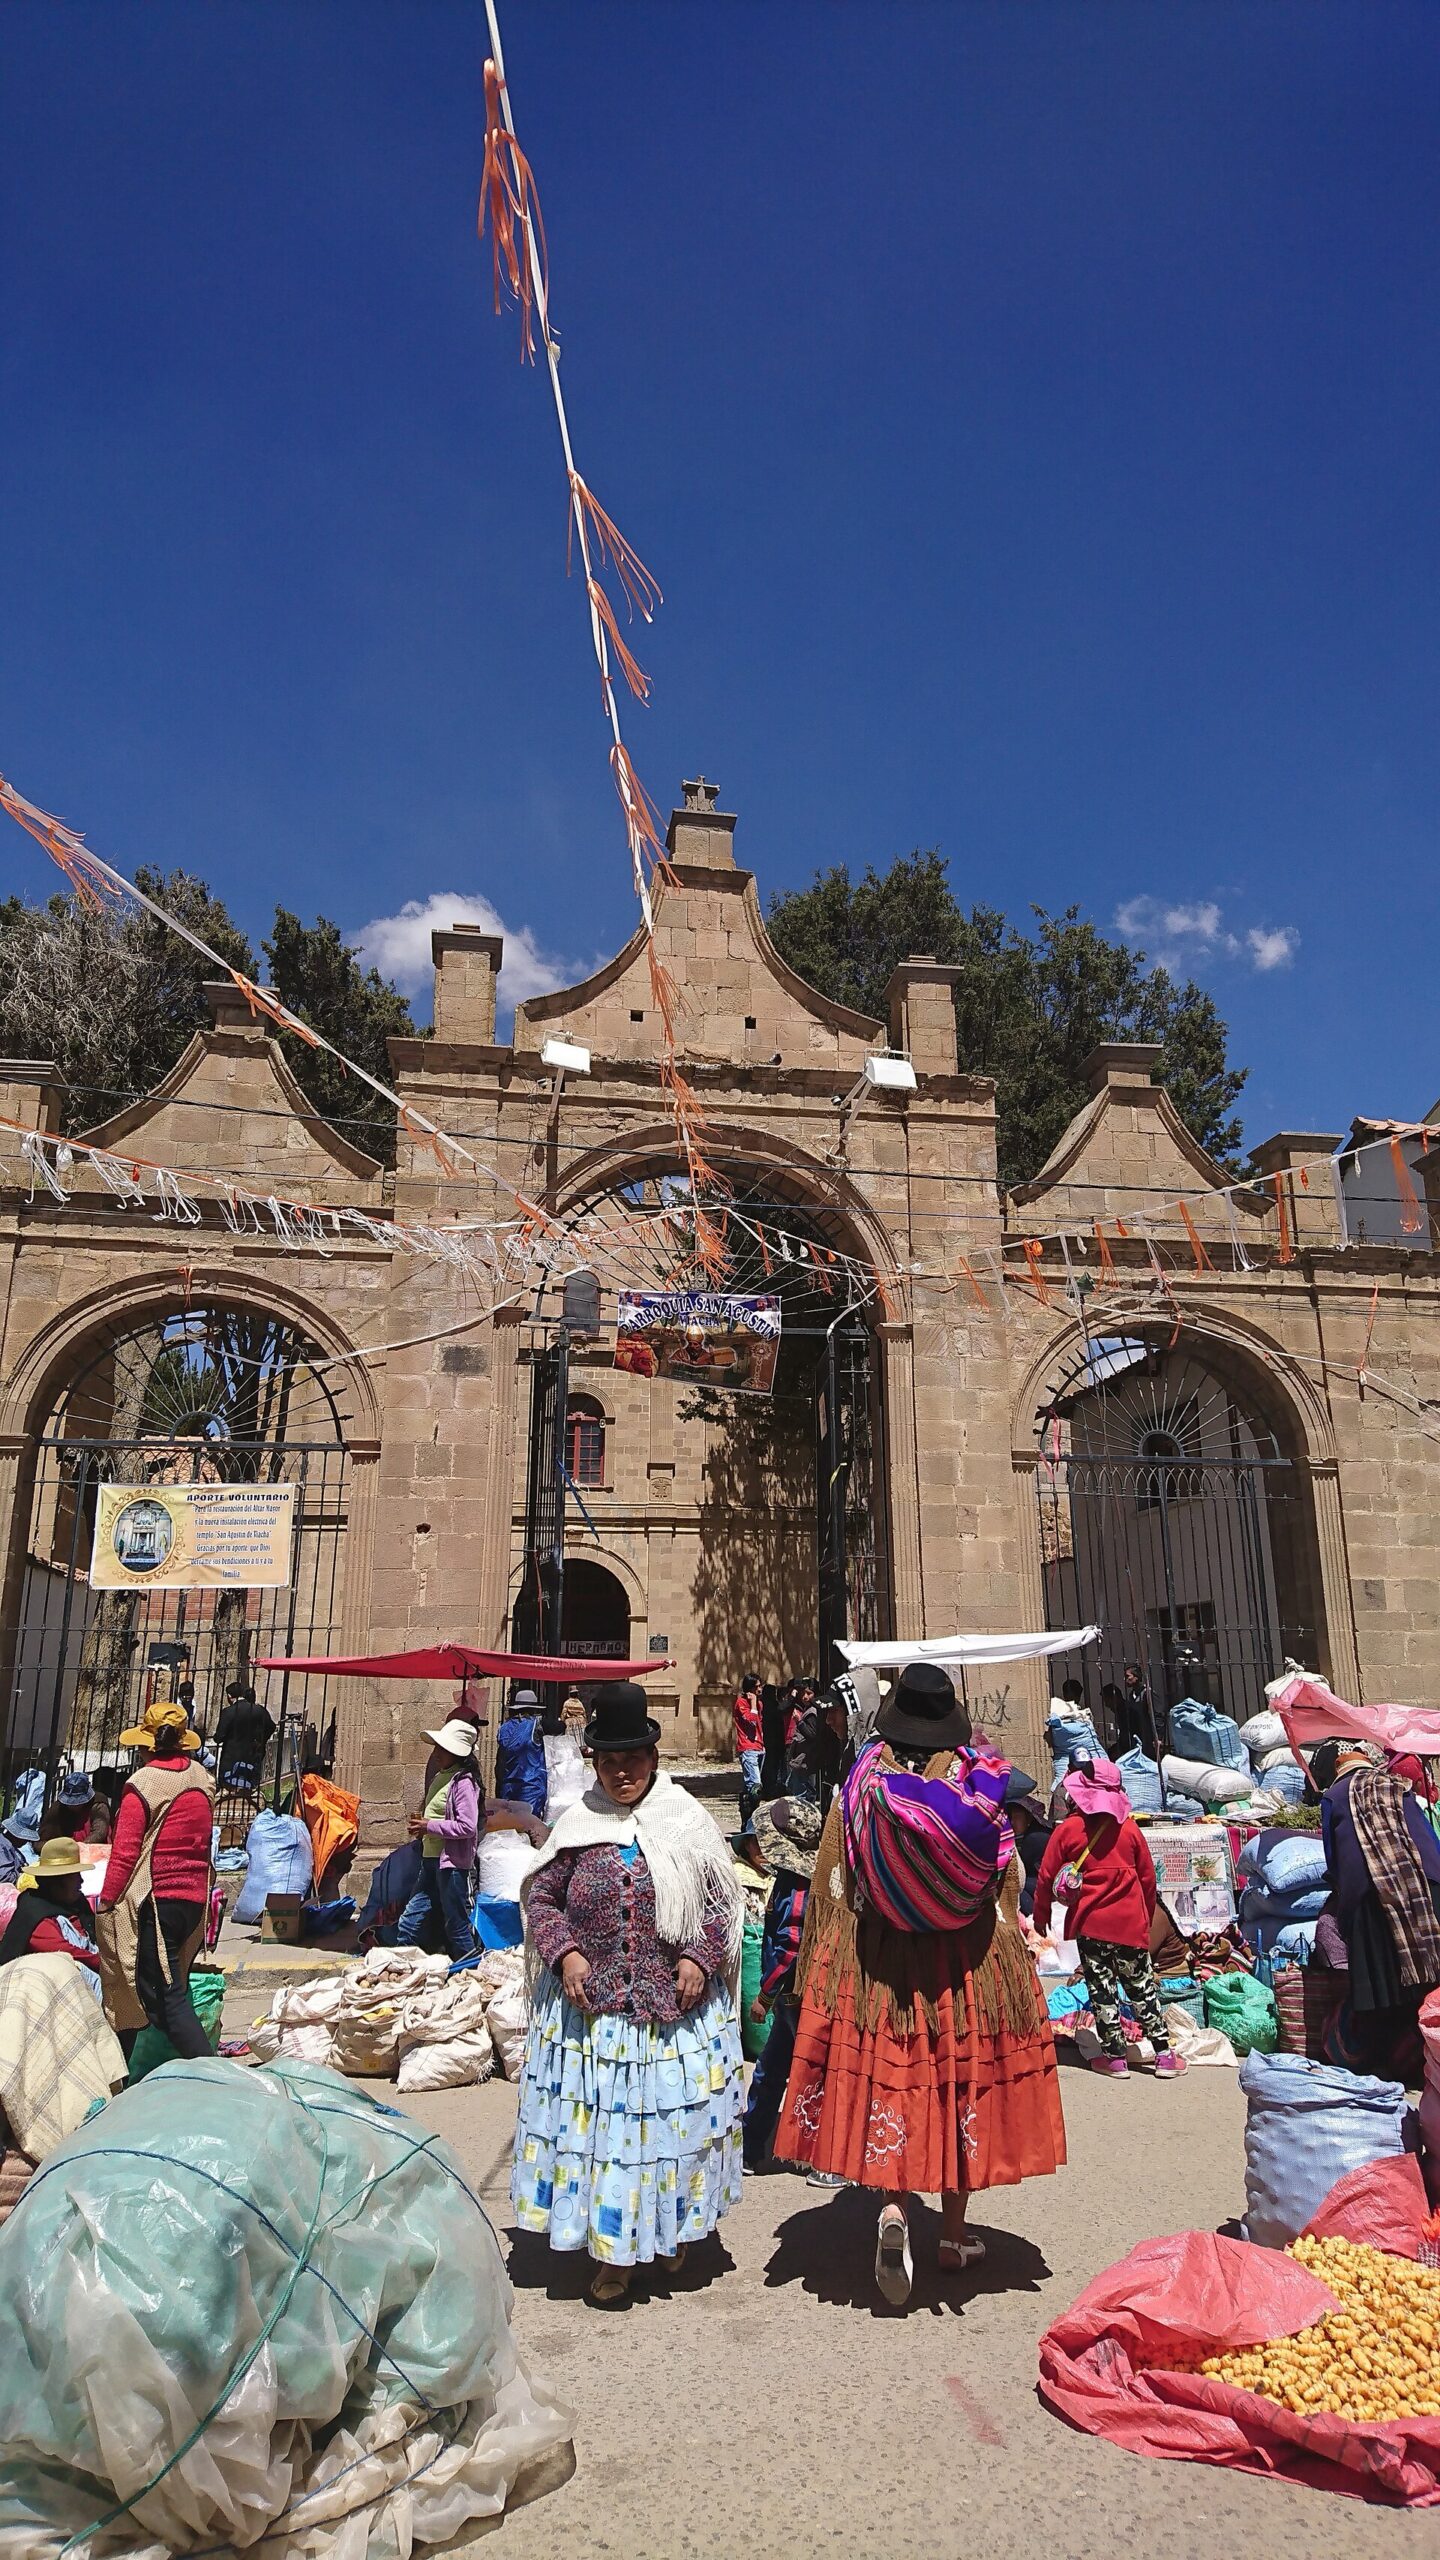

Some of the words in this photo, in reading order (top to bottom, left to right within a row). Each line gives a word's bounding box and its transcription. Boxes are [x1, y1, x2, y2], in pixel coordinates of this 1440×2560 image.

[620, 1296, 693, 1334] PARROQUIA
[696, 1295, 724, 1314] SAN
[723, 1302, 779, 1341] AGUSTIN
[680, 1314, 720, 1326] VIACHA
[244, 1504, 252, 1512] del
